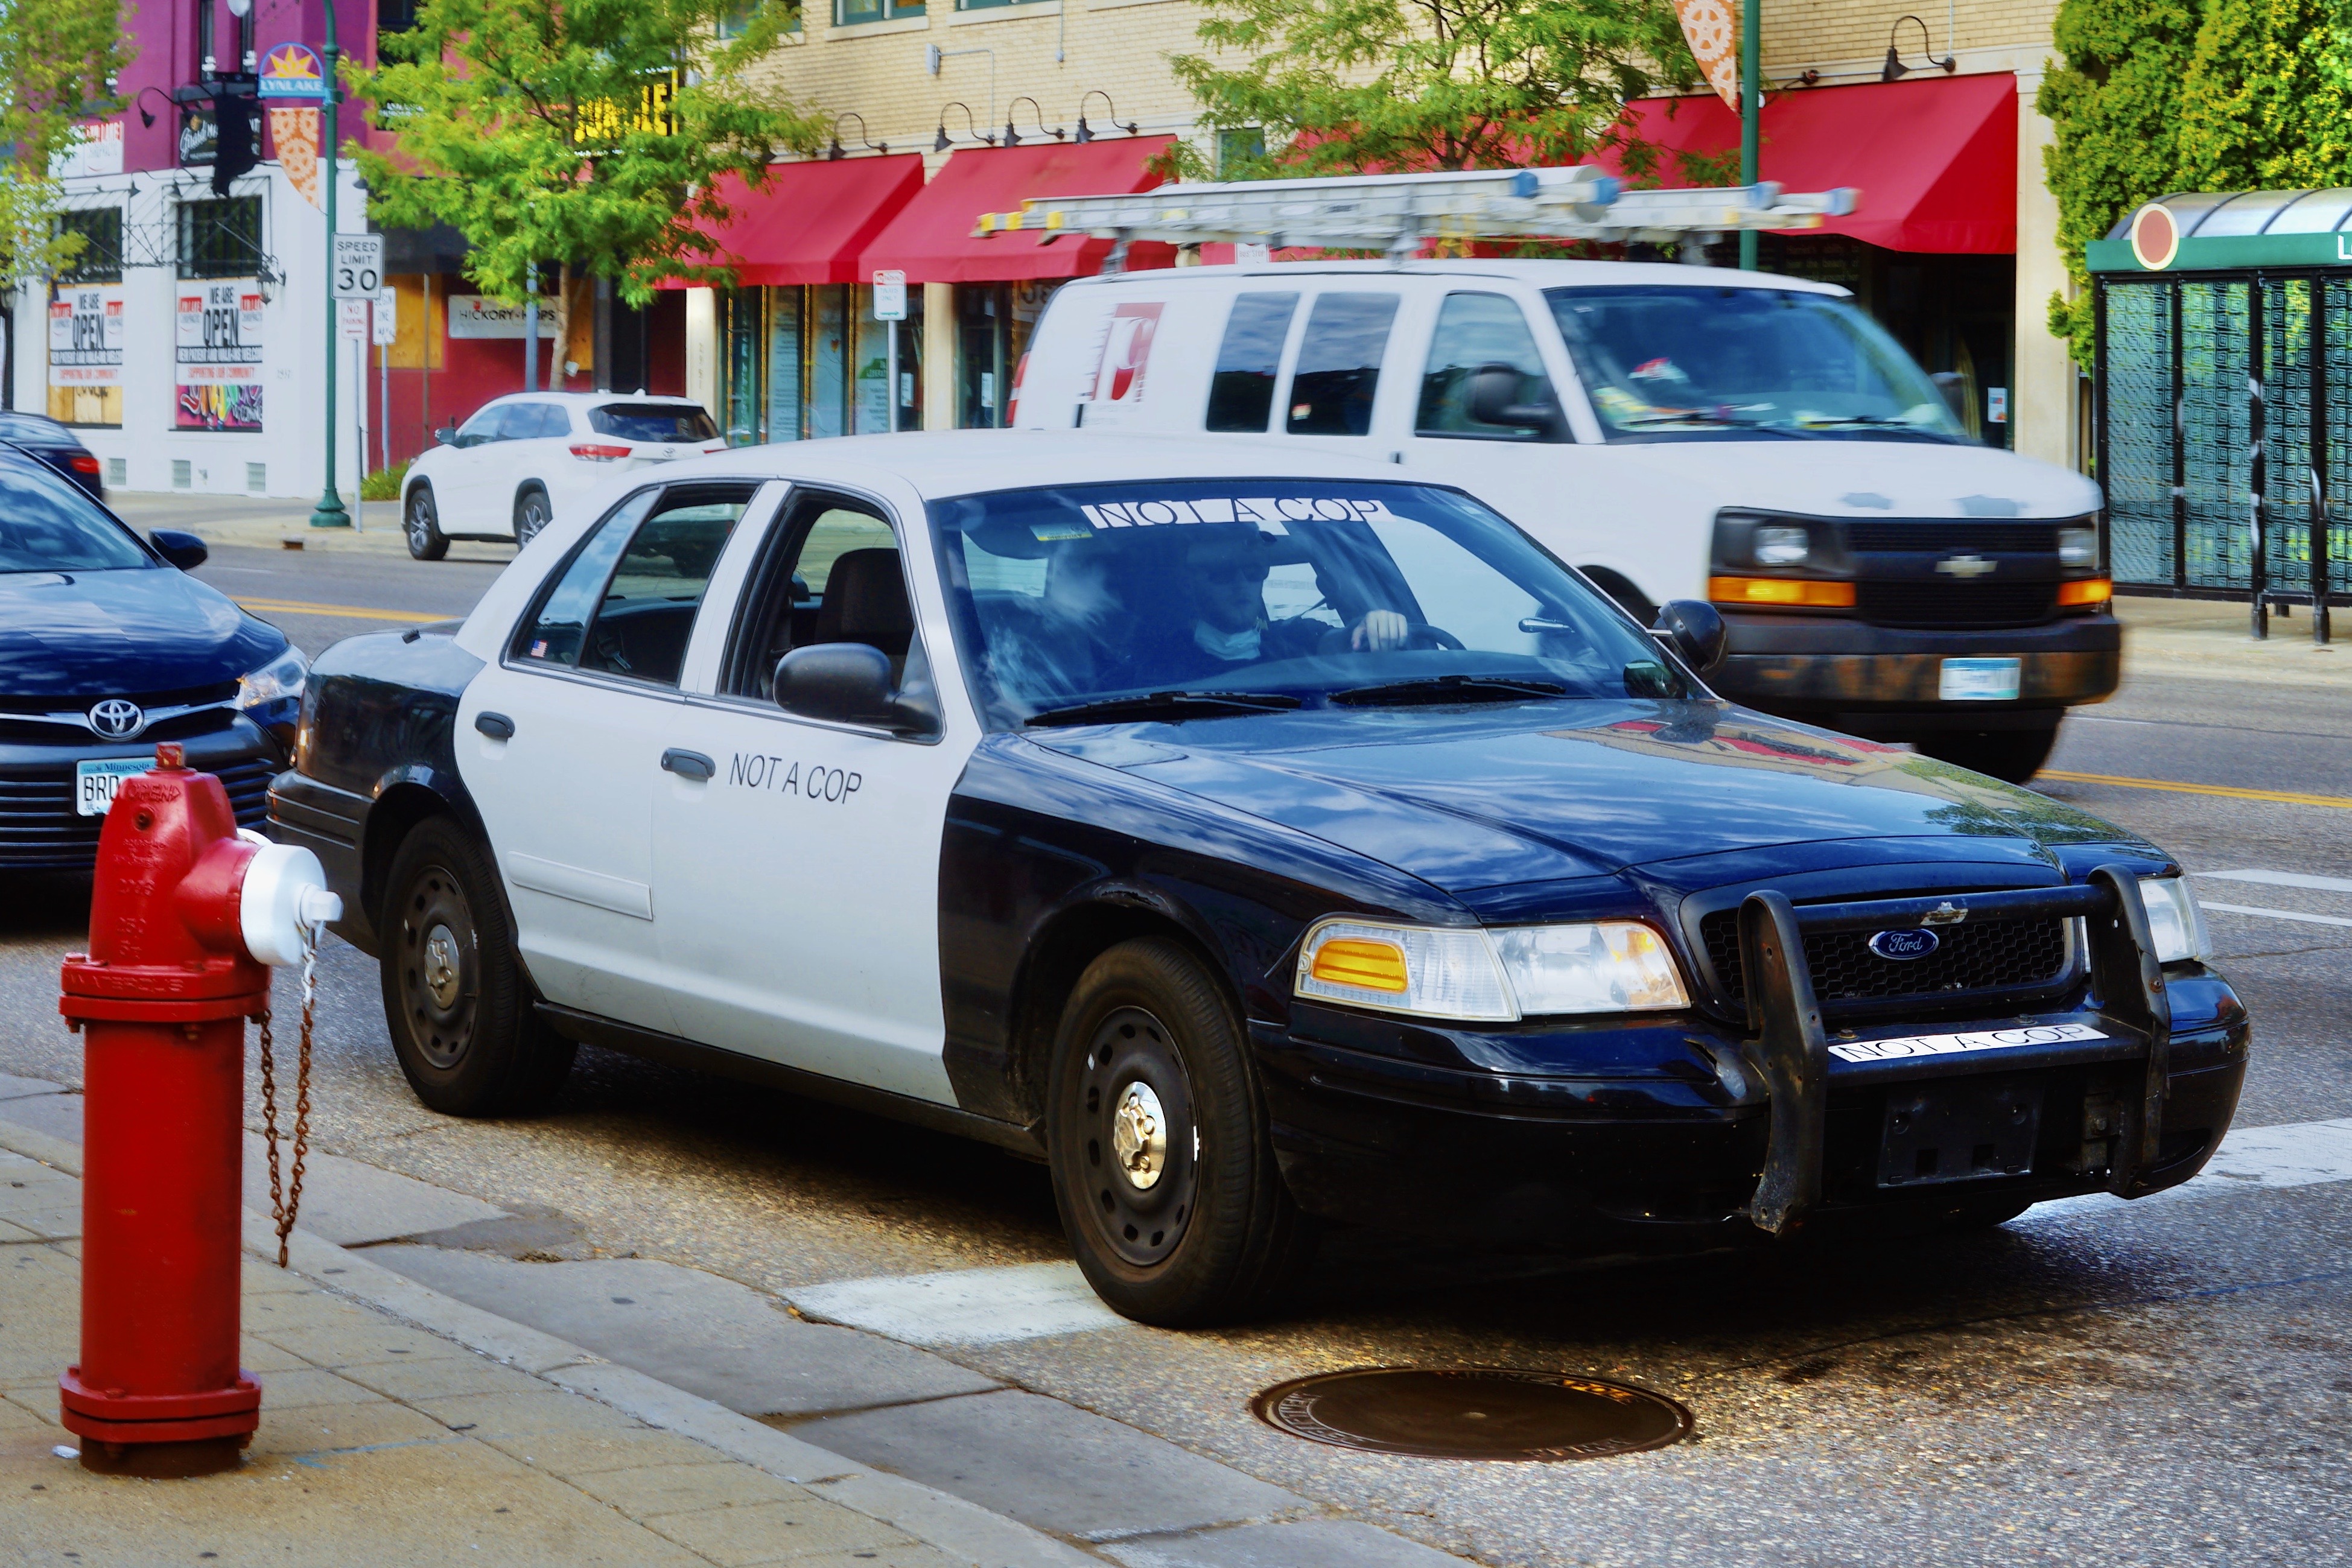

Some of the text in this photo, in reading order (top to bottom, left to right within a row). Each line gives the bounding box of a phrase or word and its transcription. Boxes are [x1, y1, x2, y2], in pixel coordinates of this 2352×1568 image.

[260, 79, 324, 92] LYNLAKE
[337, 241, 378, 252] SPEED
[2338, 235, 2352, 260] L
[341, 255, 373, 264] LIMIT
[337, 267, 377, 291] 30
[79, 293, 100, 309] WE ARE
[209, 286, 234, 303] WE ARE
[347, 305, 360, 314] NO
[459, 309, 556, 321] HICKORY HPS
[72, 313, 104, 349] OPEN
[203, 307, 239, 348] OPEN
[59, 368, 83, 379] SUPPORTING
[94, 368, 117, 379] COMMUNITY
[188, 366, 254, 378] SUPPORTING OUR COMMUNITY
[1091, 498, 1380, 529] NOT A COP
[104, 762, 150, 772] Minnesota
[729, 752, 862, 805] NOT A COP
[127, 784, 173, 802] OPEN
[1888, 933, 1923, 952] Ford
[1838, 1026, 2084, 1059] NOT A COP
